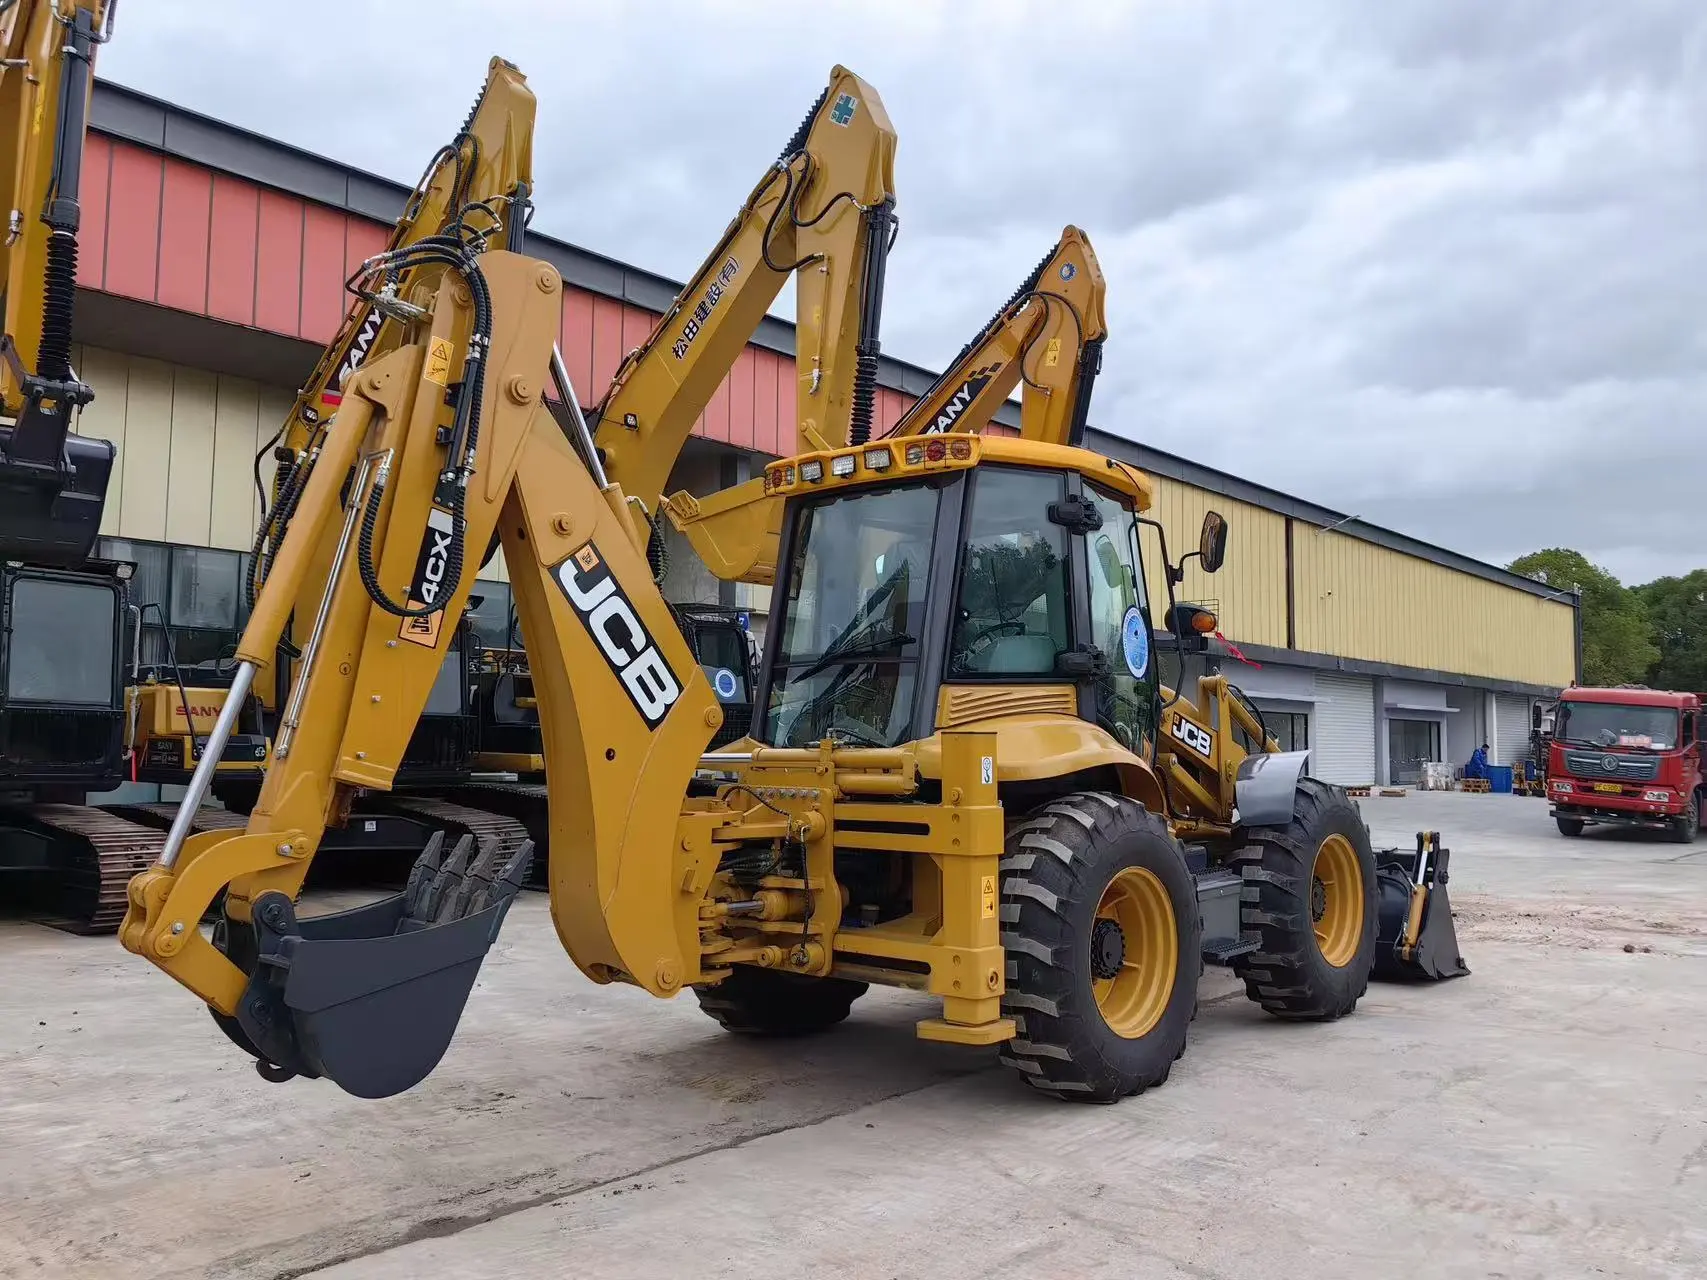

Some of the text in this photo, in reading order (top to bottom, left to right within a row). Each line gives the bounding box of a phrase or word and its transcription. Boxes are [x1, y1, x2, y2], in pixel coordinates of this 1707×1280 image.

[421, 531, 452, 604] 4CX
[411, 613, 430, 633] JC
[559, 558, 680, 721] JCB
[175, 705, 222, 717] SANY
[1172, 718, 1211, 756] JCB
